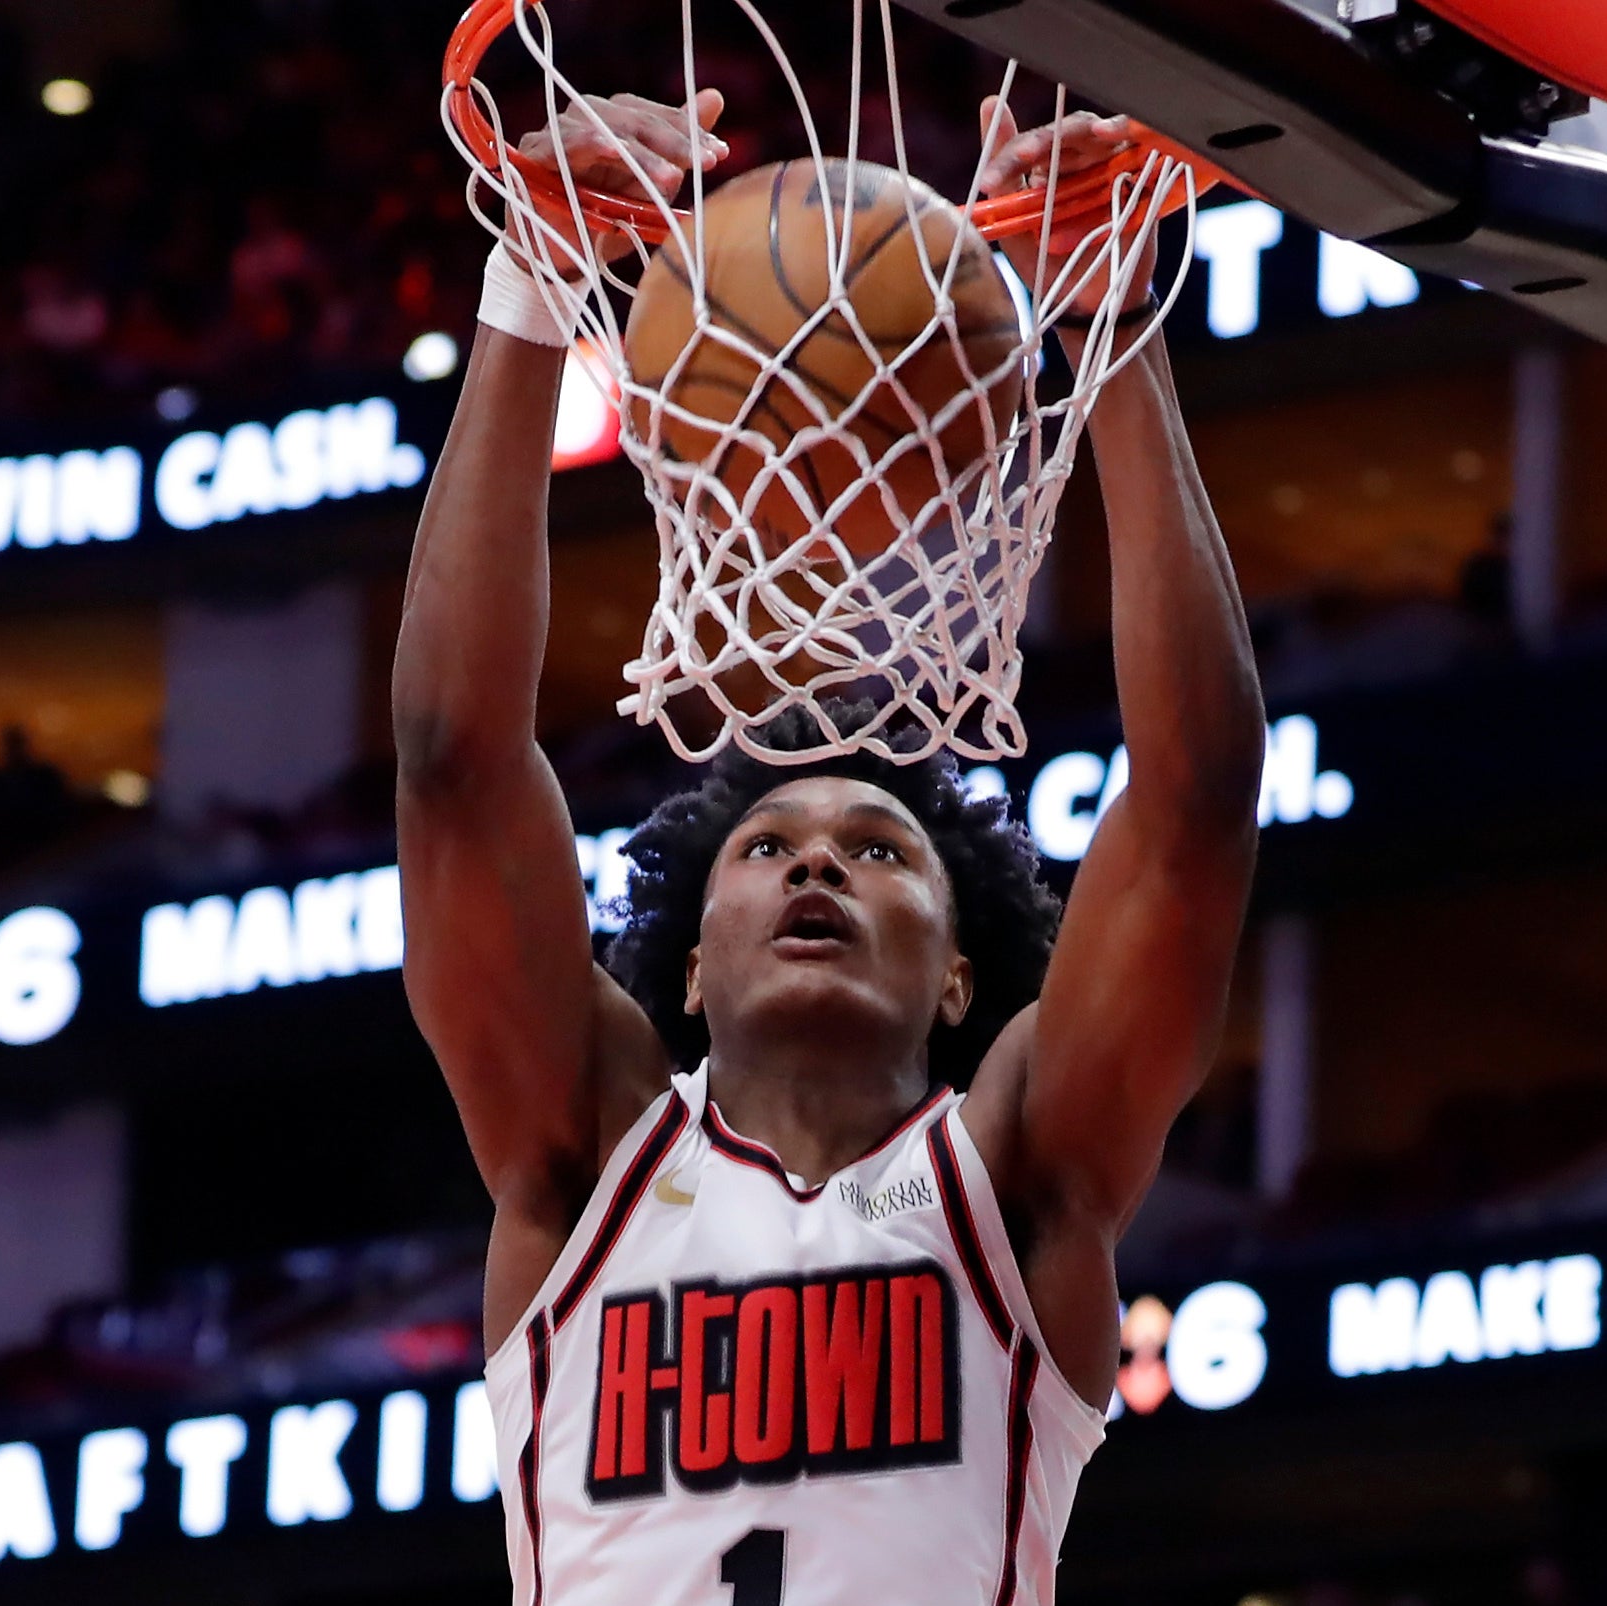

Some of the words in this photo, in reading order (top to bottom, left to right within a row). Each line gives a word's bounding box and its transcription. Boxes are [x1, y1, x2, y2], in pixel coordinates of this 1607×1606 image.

[155, 398, 426, 530] CASH.
[139, 864, 406, 1006] MAKE
[1328, 1254, 1602, 1378] MAKE
